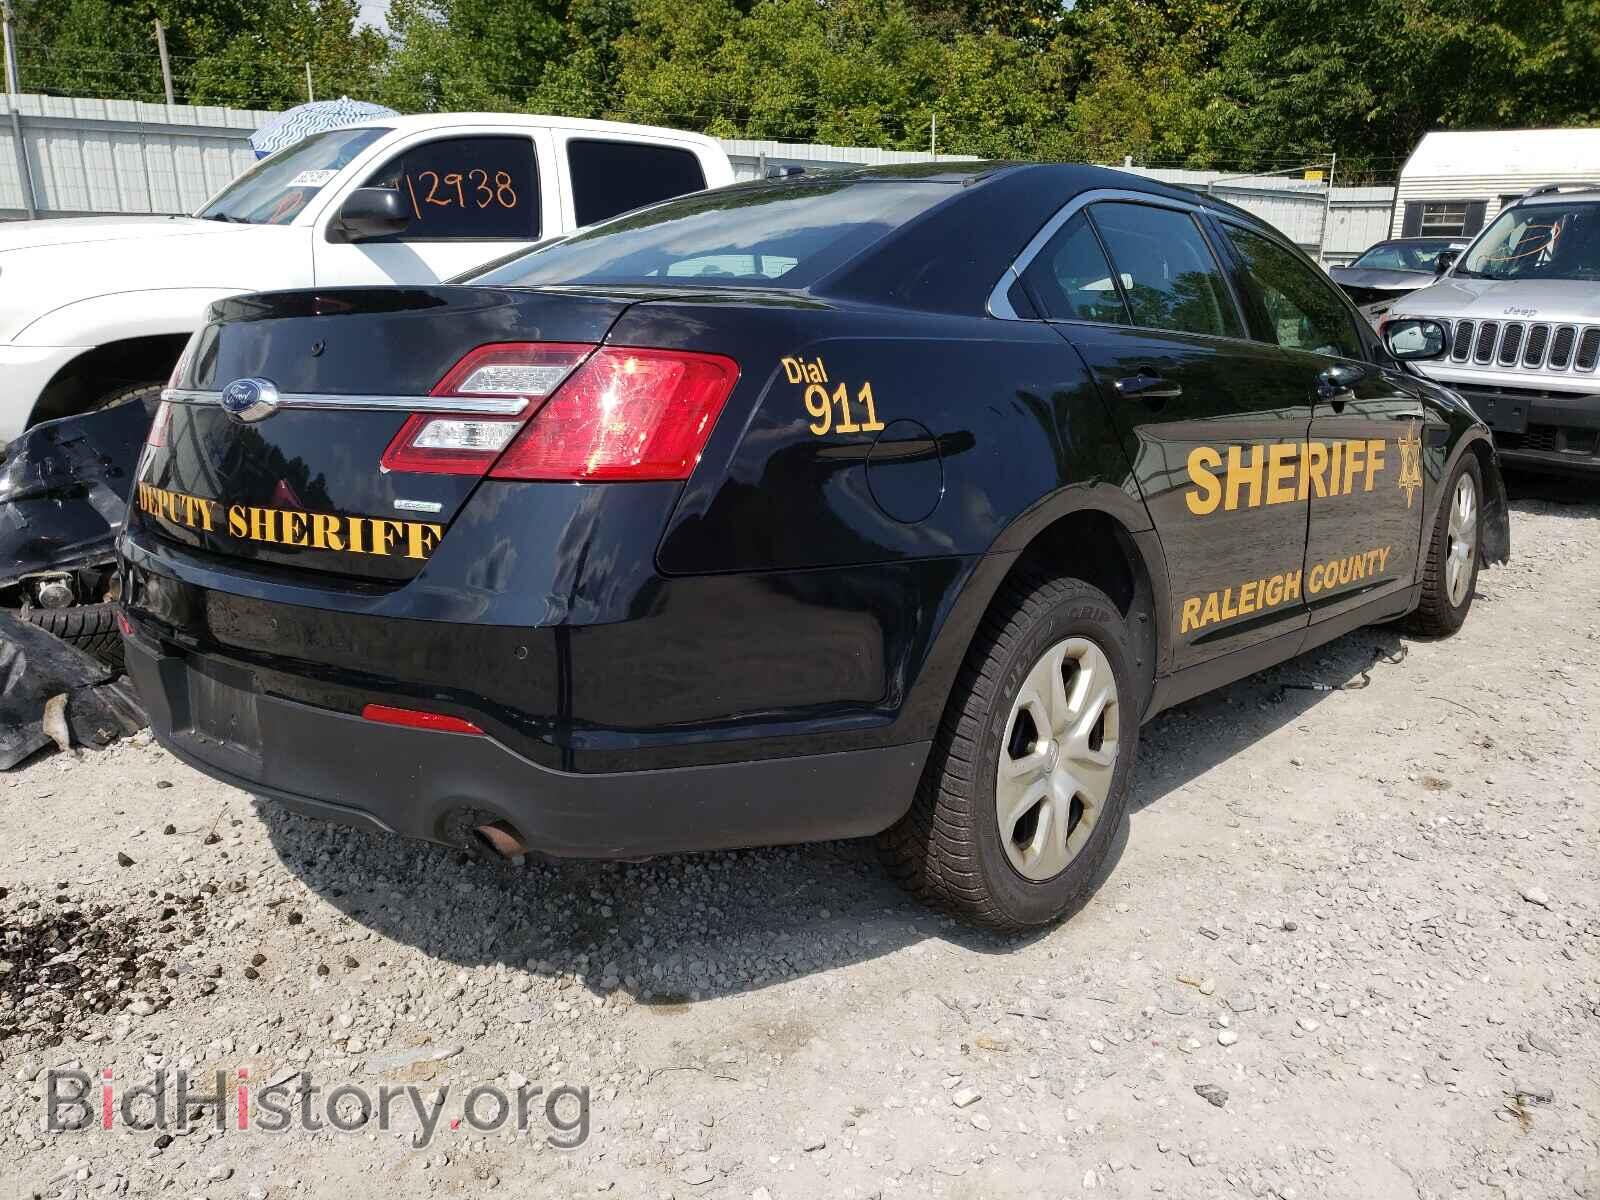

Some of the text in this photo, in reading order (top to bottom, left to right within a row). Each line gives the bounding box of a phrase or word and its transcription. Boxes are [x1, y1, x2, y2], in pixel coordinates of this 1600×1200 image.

[406, 169, 517, 219] 12938
[781, 357, 829, 384] Dial
[804, 382, 885, 435] 911
[1185, 439, 1386, 515] SHERIFF
[137, 481, 442, 560] DEPUTY SHERIFF
[1180, 546, 1391, 634] RALEIGH COUNTY
